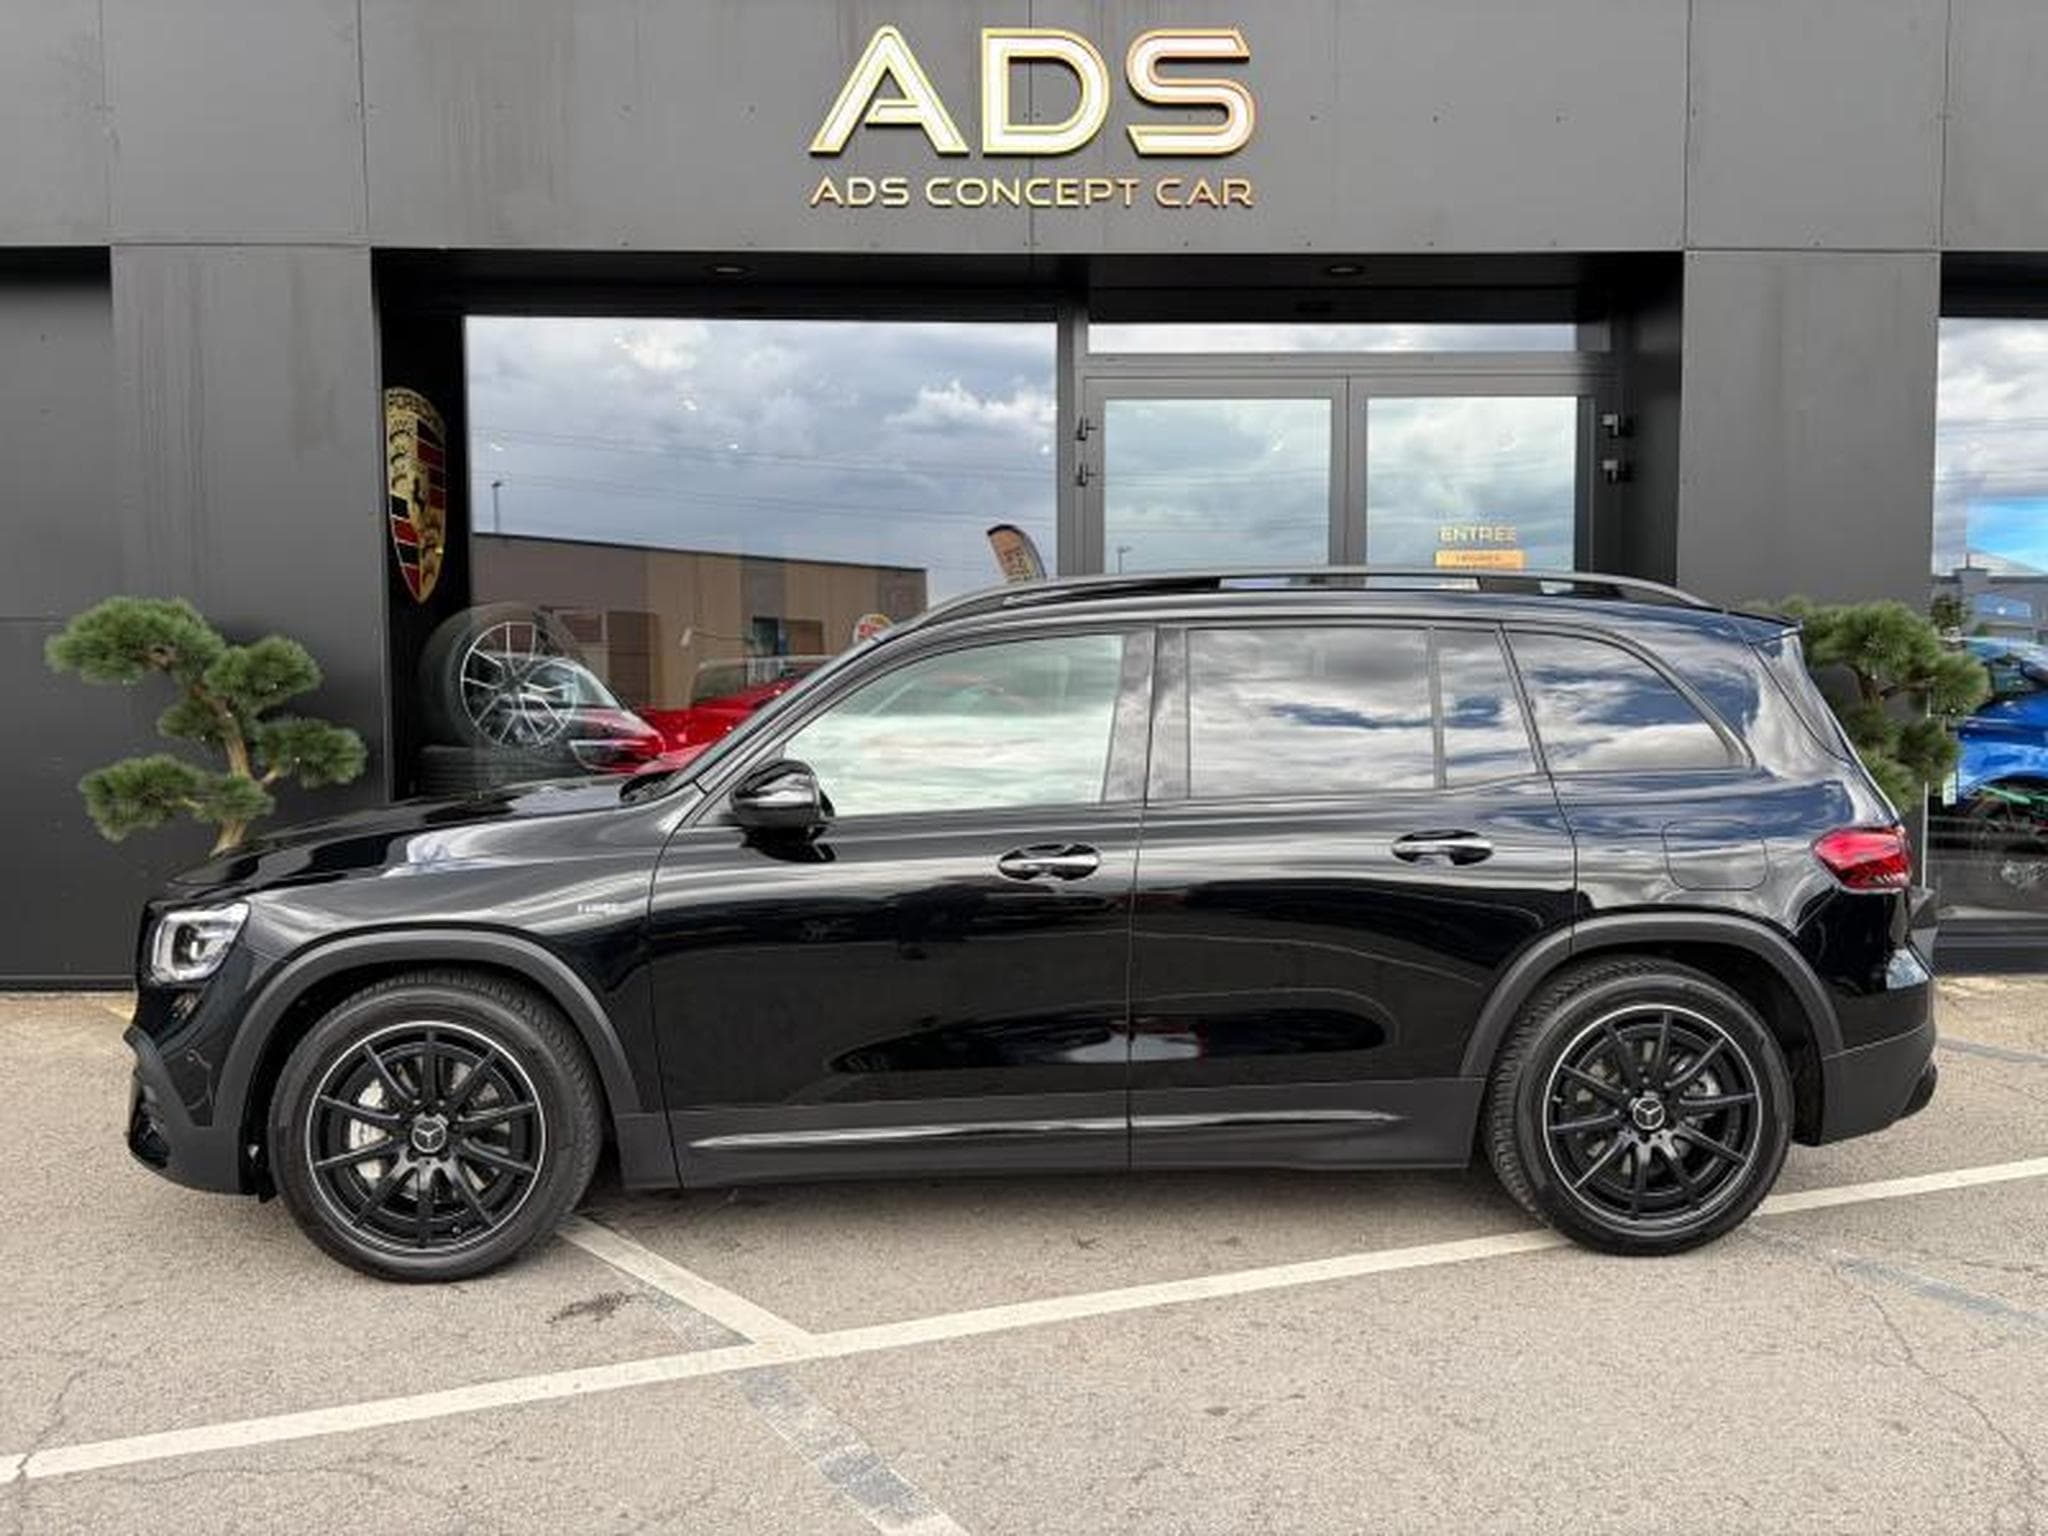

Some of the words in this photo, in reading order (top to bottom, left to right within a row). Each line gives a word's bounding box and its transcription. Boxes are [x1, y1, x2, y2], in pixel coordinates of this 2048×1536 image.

[809, 25, 1256, 155] ADS
[810, 177, 909, 207] ADS
[925, 177, 1138, 207] CONCEPT
[1155, 177, 1254, 207] CAR
